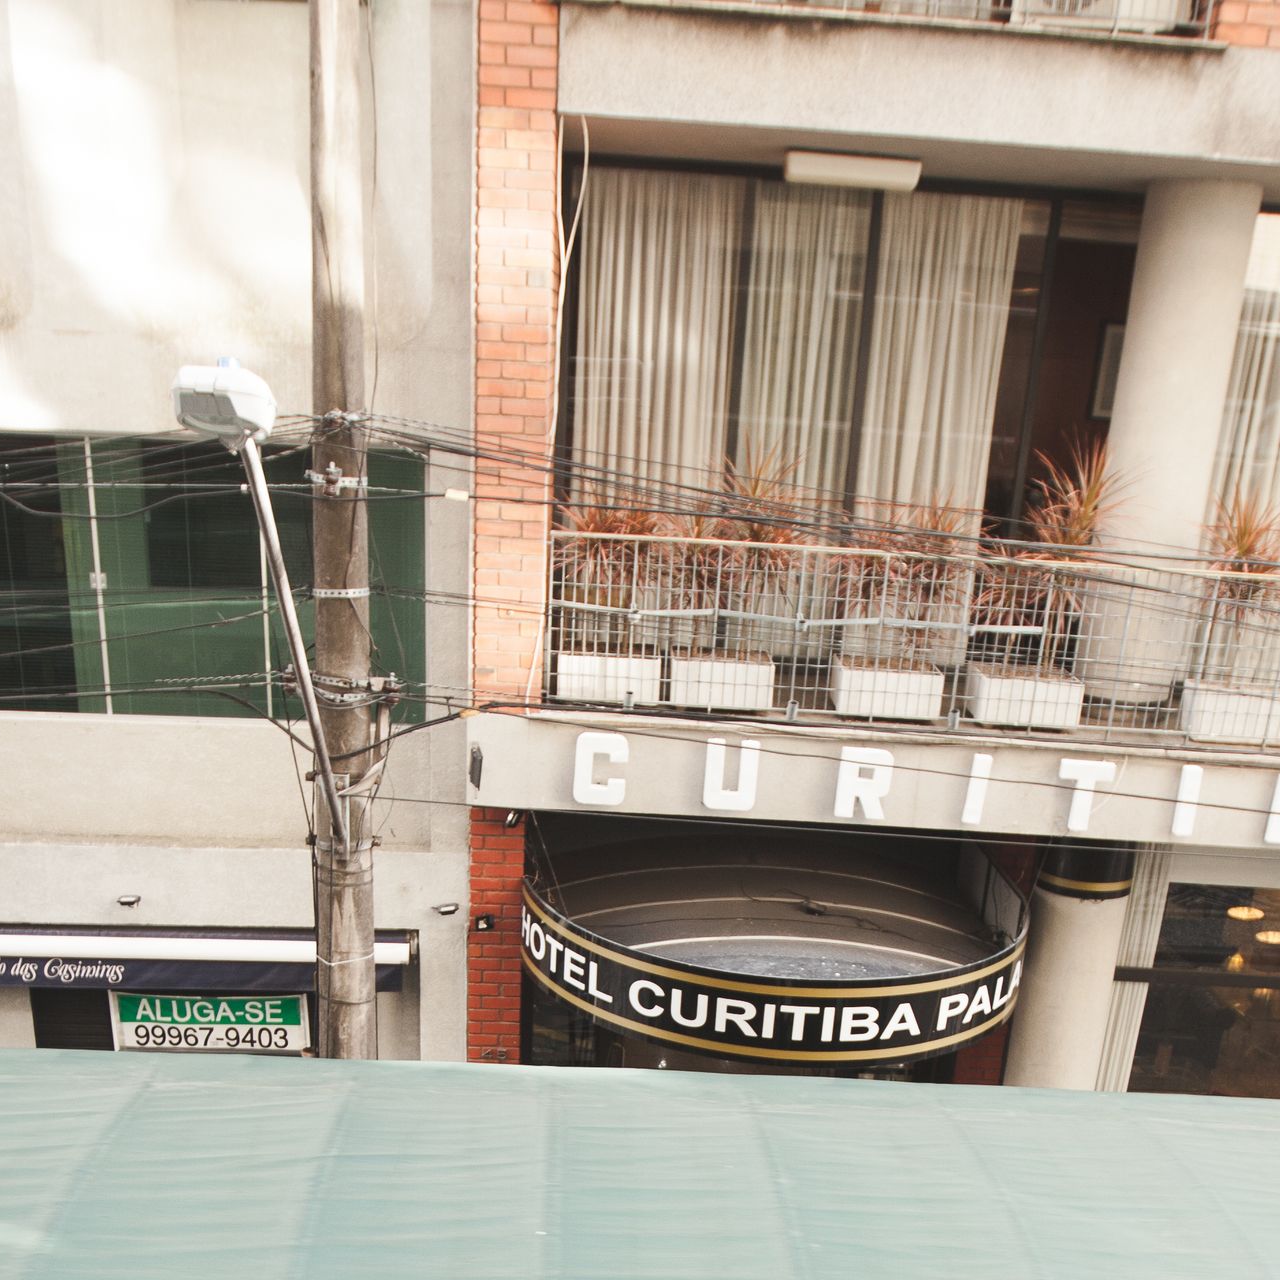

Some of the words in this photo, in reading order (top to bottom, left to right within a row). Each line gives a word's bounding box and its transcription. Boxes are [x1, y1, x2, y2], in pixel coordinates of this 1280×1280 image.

[10, 957, 38, 982] das
[43, 957, 125, 984] Casimiras
[521, 905, 613, 1003] HOTEL
[629, 979, 920, 1042] CURITIBA
[135, 998, 283, 1024] ALUGA-SE
[134, 1024, 289, 1049] 99967-9403
